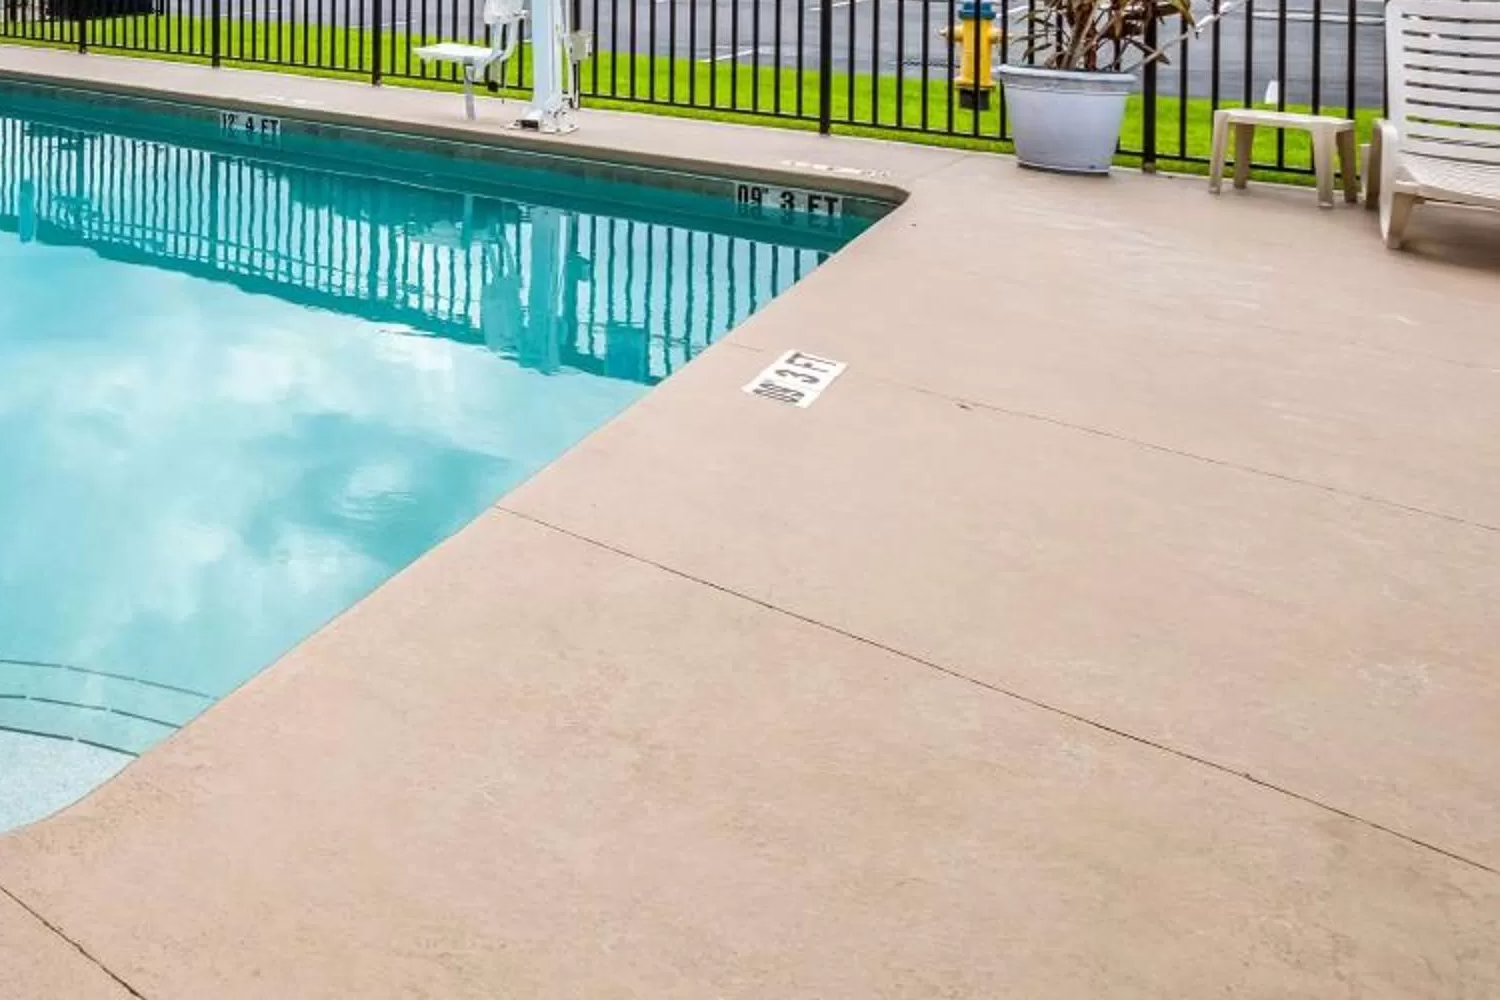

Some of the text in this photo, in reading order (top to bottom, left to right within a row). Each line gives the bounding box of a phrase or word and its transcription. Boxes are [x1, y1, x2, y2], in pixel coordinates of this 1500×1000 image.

[245, 116, 255, 132] 4
[261, 118, 279, 134] FT
[779, 190, 795, 210] 3
[807, 193, 839, 216] FT
[784, 351, 838, 374] FT
[774, 368, 821, 385] 3
